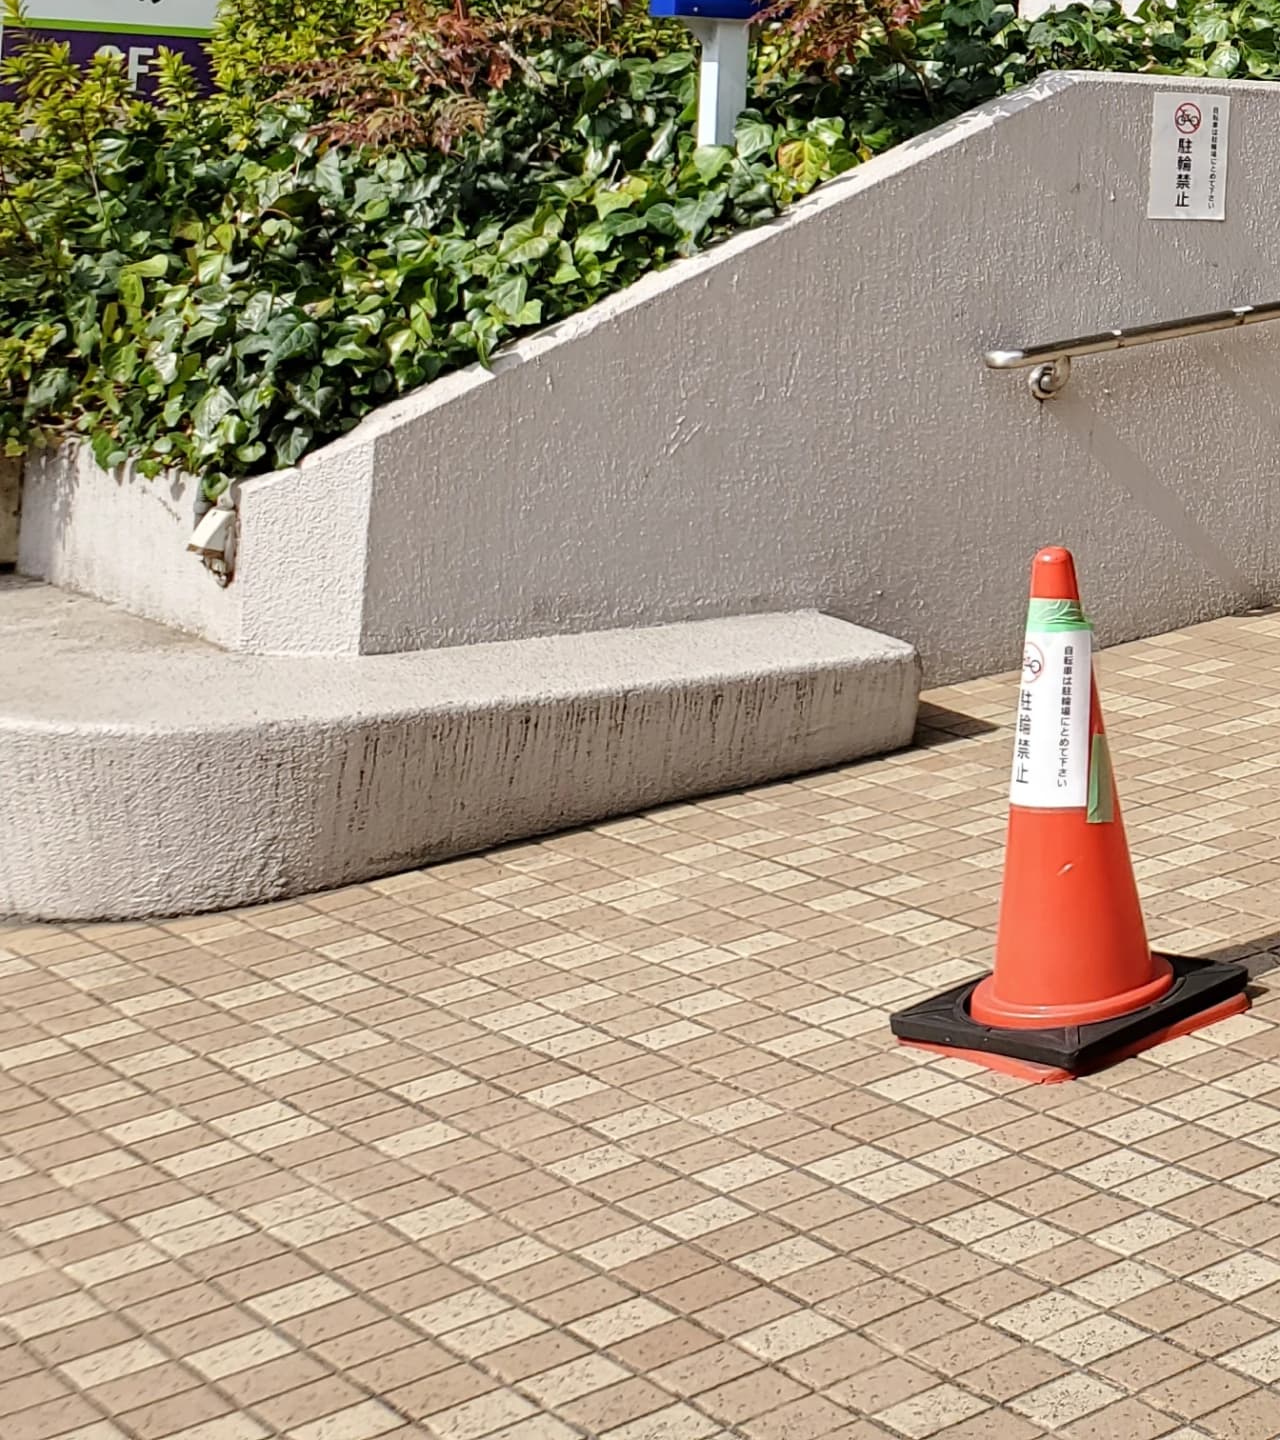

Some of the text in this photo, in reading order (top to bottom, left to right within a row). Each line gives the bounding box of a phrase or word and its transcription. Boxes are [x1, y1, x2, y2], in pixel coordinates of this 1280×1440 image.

[1175, 137, 1193, 208] 駐輪禁止
[1057, 645, 1074, 788] 自転車は駐輪場にとめて下さい
